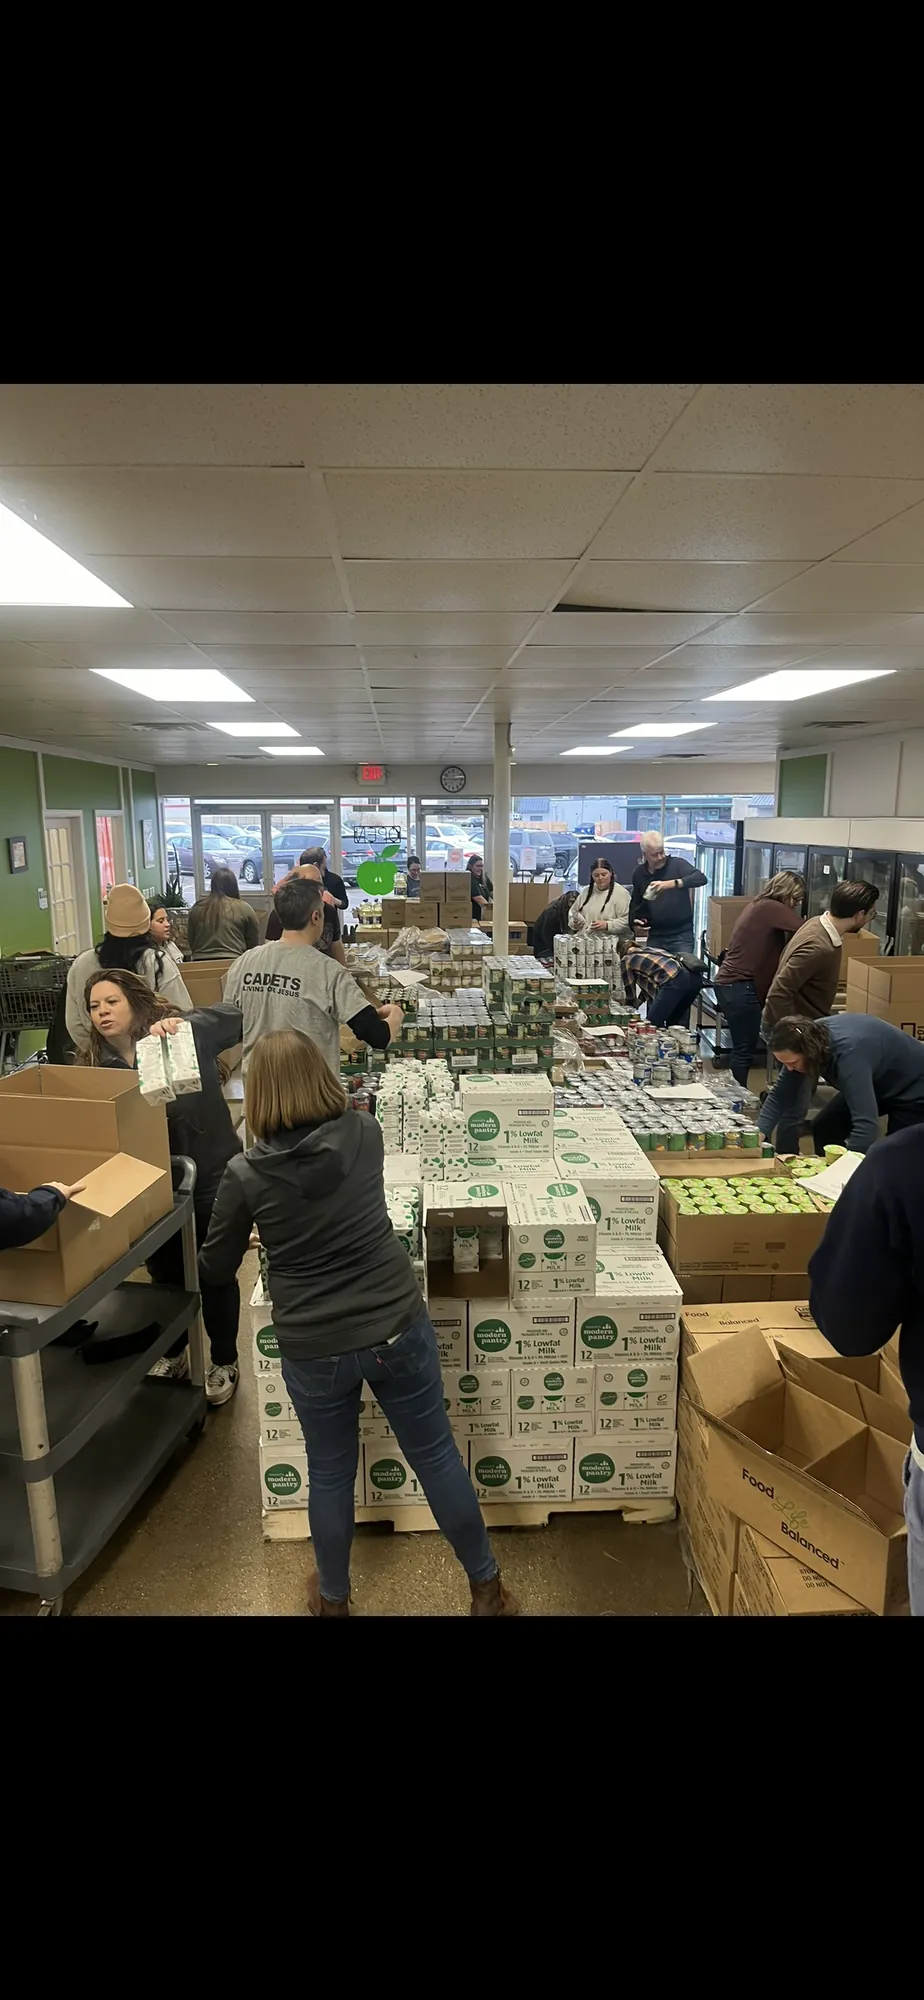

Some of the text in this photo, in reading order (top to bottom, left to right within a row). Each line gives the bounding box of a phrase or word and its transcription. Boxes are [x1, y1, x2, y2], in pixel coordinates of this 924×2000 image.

[362, 767, 382, 781] EXIT
[243, 973, 302, 991] CADETS
[277, 989, 300, 997] JESUS
[504, 1130, 517, 1143] 1%
[468, 1143, 479, 1151] 12
[605, 1217, 619, 1230] 1%
[518, 1280, 530, 1290] 12
[719, 1317, 760, 1326] Balanced
[515, 1339, 561, 1354] 1% Lowfat
[621, 1337, 637, 1351] 1%
[474, 1354, 486, 1363] 12
[581, 1350, 592, 1359] 12
[258, 1360, 270, 1369] 12
[518, 1422, 530, 1431] 12
[600, 1419, 611, 1428] 12
[266, 1429, 278, 1439] 12
[515, 1476, 530, 1489] 1%
[618, 1473, 634, 1486] 1%
[742, 1467, 775, 1500] Food
[476, 1489, 487, 1497] 12
[579, 1485, 590, 1494] 12
[371, 1491, 382, 1500] 12
[267, 1496, 278, 1505] 12
[781, 1521, 839, 1570] Balanced
